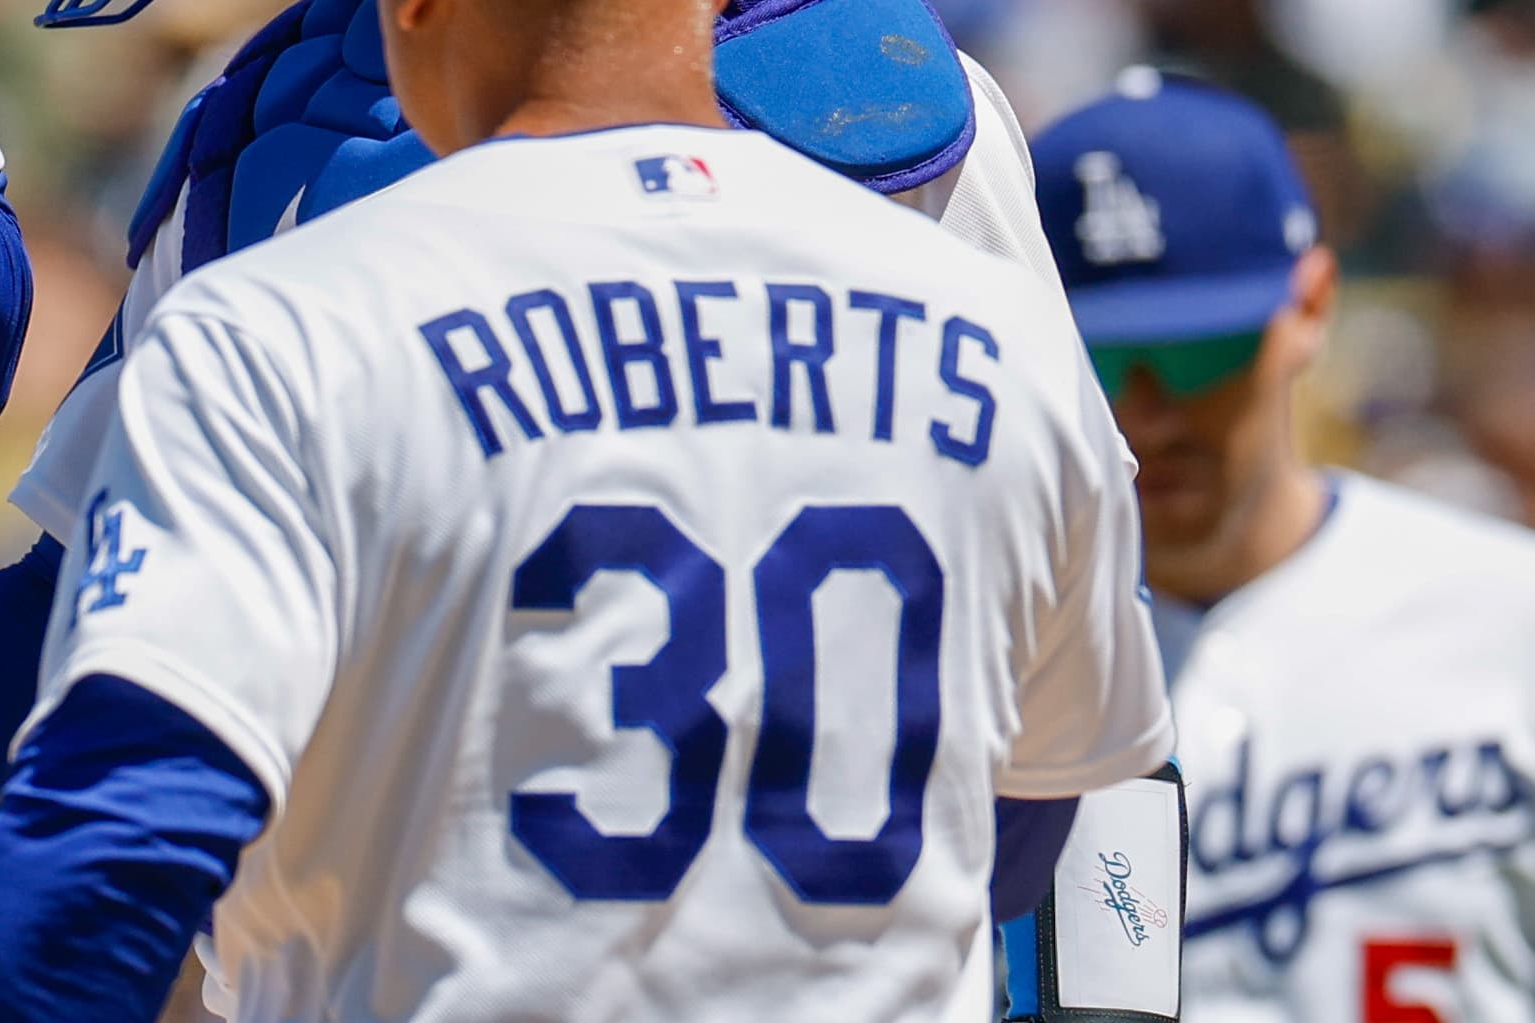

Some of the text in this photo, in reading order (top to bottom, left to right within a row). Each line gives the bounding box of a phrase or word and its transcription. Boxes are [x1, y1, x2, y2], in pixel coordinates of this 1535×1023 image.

[417, 280, 1002, 469] ROBERTS
[508, 503, 945, 906] 30
[1097, 851, 1150, 947] Dodgers
[1184, 731, 1535, 968] dgers
